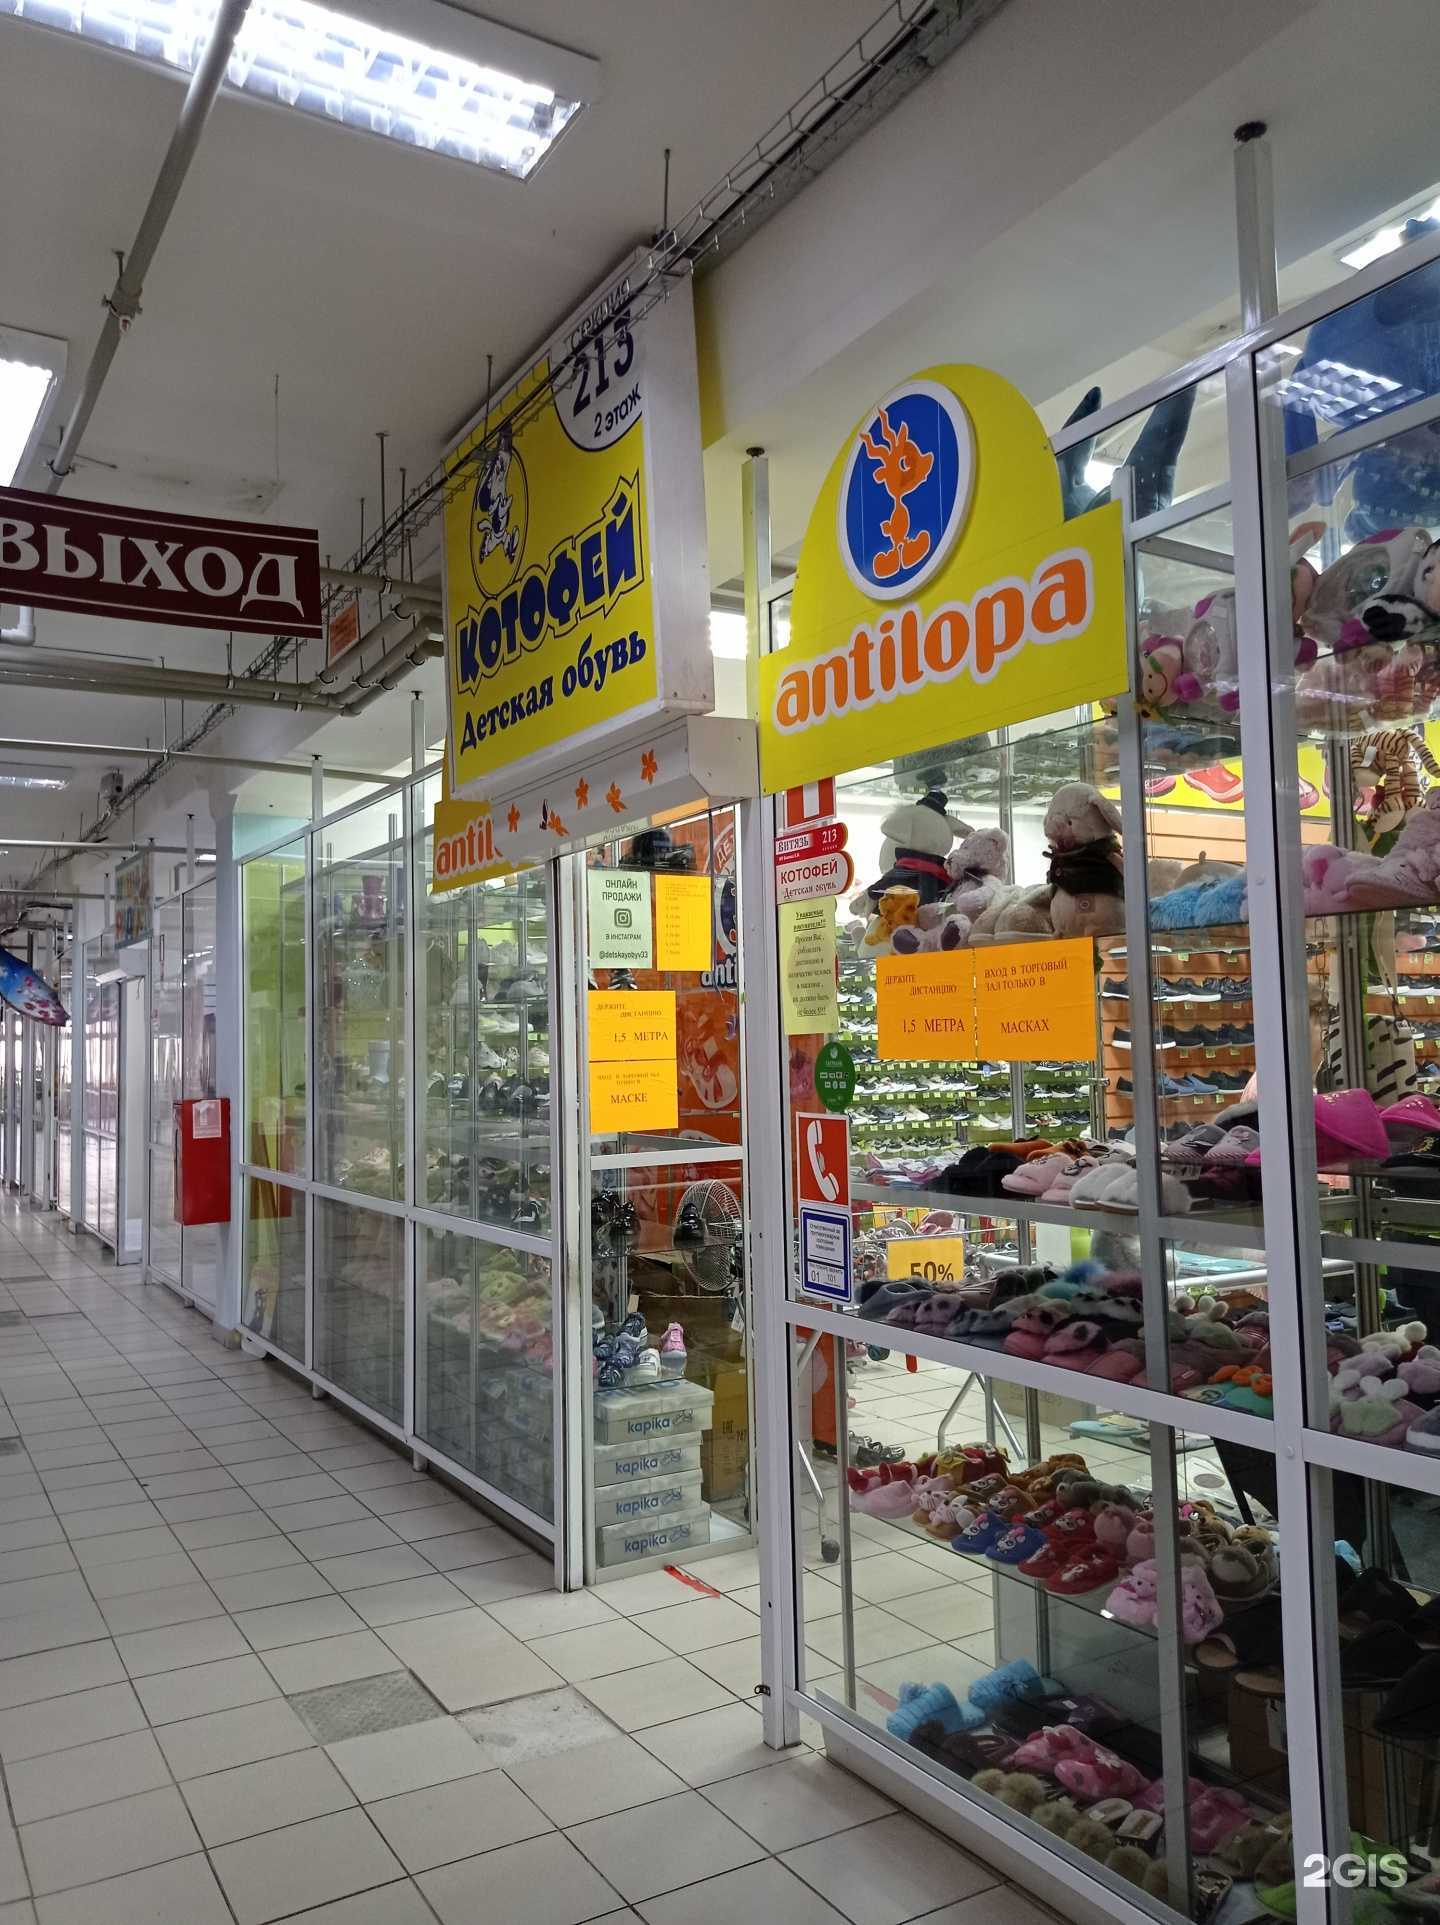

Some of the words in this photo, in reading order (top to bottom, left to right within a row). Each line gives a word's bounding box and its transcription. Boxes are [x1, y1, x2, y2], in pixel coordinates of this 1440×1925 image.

[573, 308, 634, 418] 213
[594, 412, 603, 438] 2
[605, 382, 642, 433] этаж
[0, 517, 305, 618] ВЫХОД
[459, 490, 637, 685] КОТОФЕЙ
[776, 558, 1088, 728] antilopa
[460, 677, 554, 757] Детская
[562, 629, 646, 692] обувь
[822, 829, 837, 844] 213
[436, 818, 503, 875] antil
[780, 858, 838, 884] КОТОФЕЙ
[605, 878, 638, 889] ОНЛАЙН
[784, 886, 813, 899] Детская
[816, 881, 837, 893] обувь
[602, 891, 642, 902] ПРОДАЖИ
[984, 967, 1007, 979] ВХОД
[1011, 966, 1017, 976] В
[1021, 959, 1067, 975] ТОРГОВЫЙ
[1003, 978, 1036, 990] ТОЛЬКО
[1040, 976, 1046, 986] В
[924, 1018, 966, 1033] МЕТРА
[1001, 1019, 1050, 1034] МАСКАХ
[634, 1031, 669, 1041] МЕТРА
[610, 1093, 648, 1104] МАСКЕ
[811, 1270, 820, 1282] 01
[910, 1261, 955, 1282] 50%
[627, 1416, 670, 1434] kapika
[615, 1457, 658, 1475] kapika
[616, 1496, 659, 1515] kapika
[624, 1533, 667, 1553] kapika
